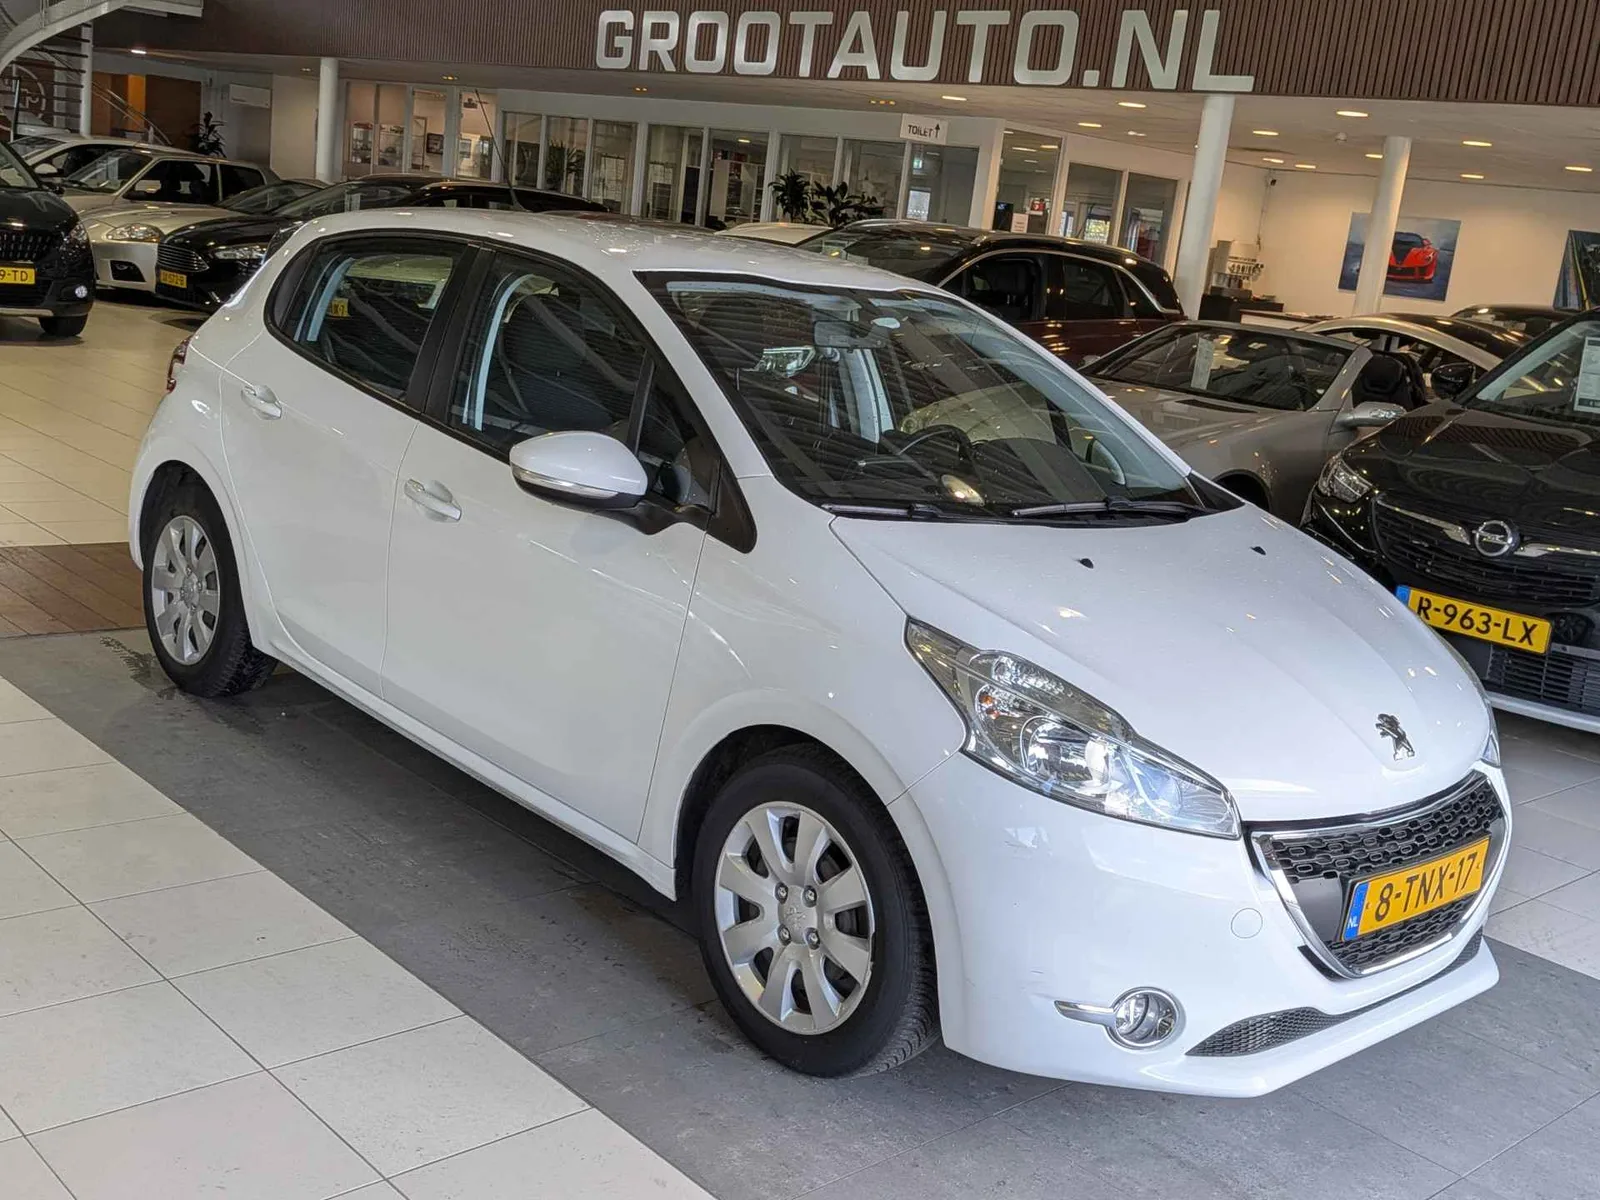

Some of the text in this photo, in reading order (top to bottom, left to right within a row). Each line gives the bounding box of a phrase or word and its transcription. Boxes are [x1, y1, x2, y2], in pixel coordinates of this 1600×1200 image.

[595, 9, 1254, 93] GROOTAUTO.NL
[907, 124, 934, 138] TOILET
[1416, 596, 1538, 646] R-963-LX
[1374, 851, 1478, 922] 8-TNX-17
